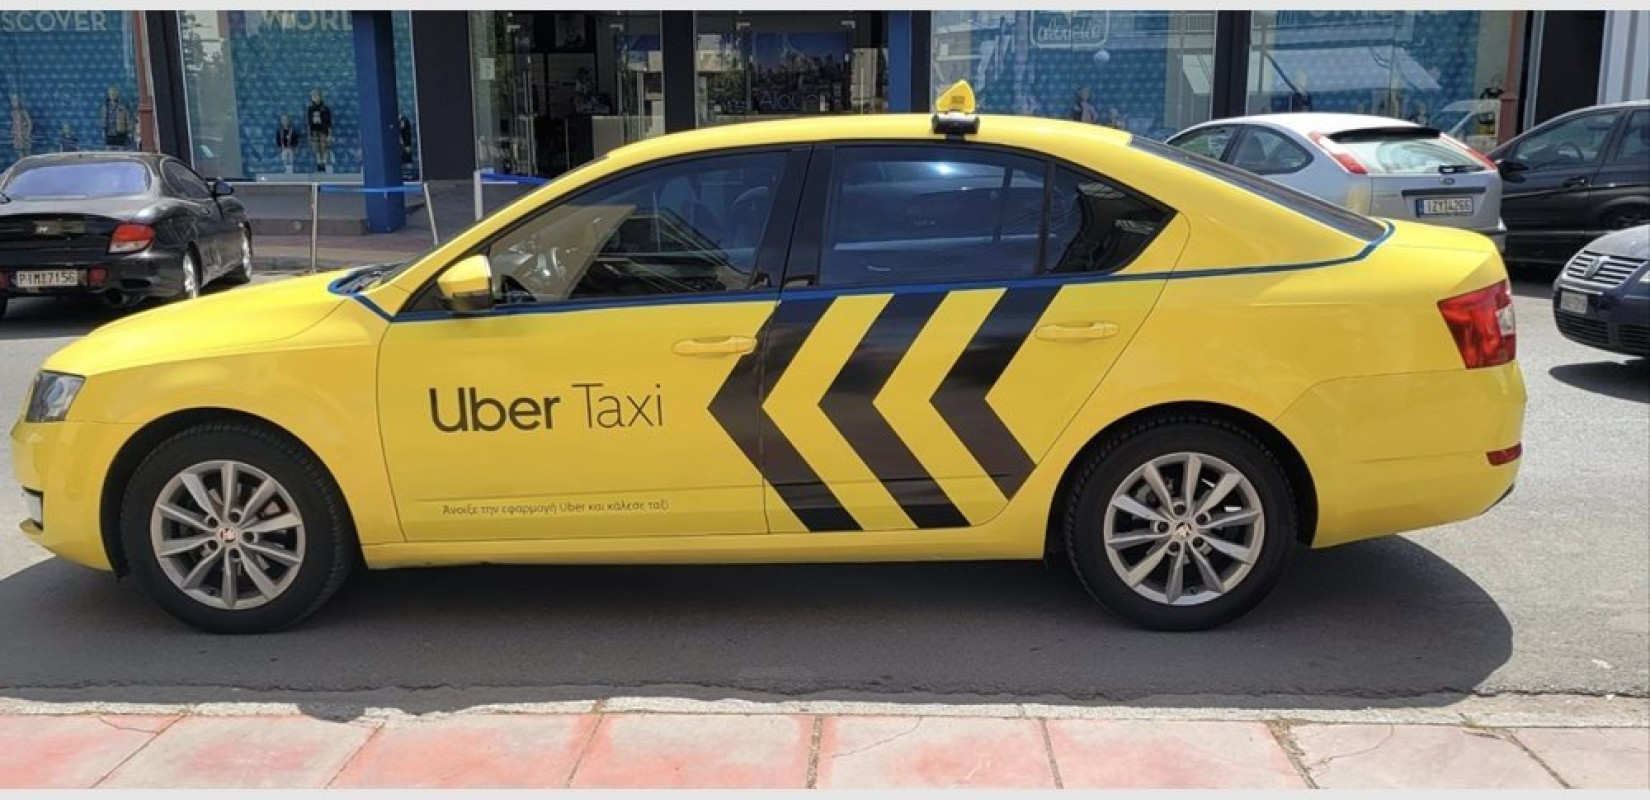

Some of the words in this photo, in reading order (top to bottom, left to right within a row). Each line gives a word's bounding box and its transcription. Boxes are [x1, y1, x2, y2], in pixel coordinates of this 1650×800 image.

[429, 387, 561, 433] Uber
[571, 383, 663, 429] Taxi
[443, 504, 478, 516] Άνοιξε
[481, 505, 500, 517] την
[501, 502, 557, 516] εφαρμογή
[559, 502, 586, 513] Uber
[588, 503, 605, 511] και
[606, 499, 645, 511] κάλεσε
